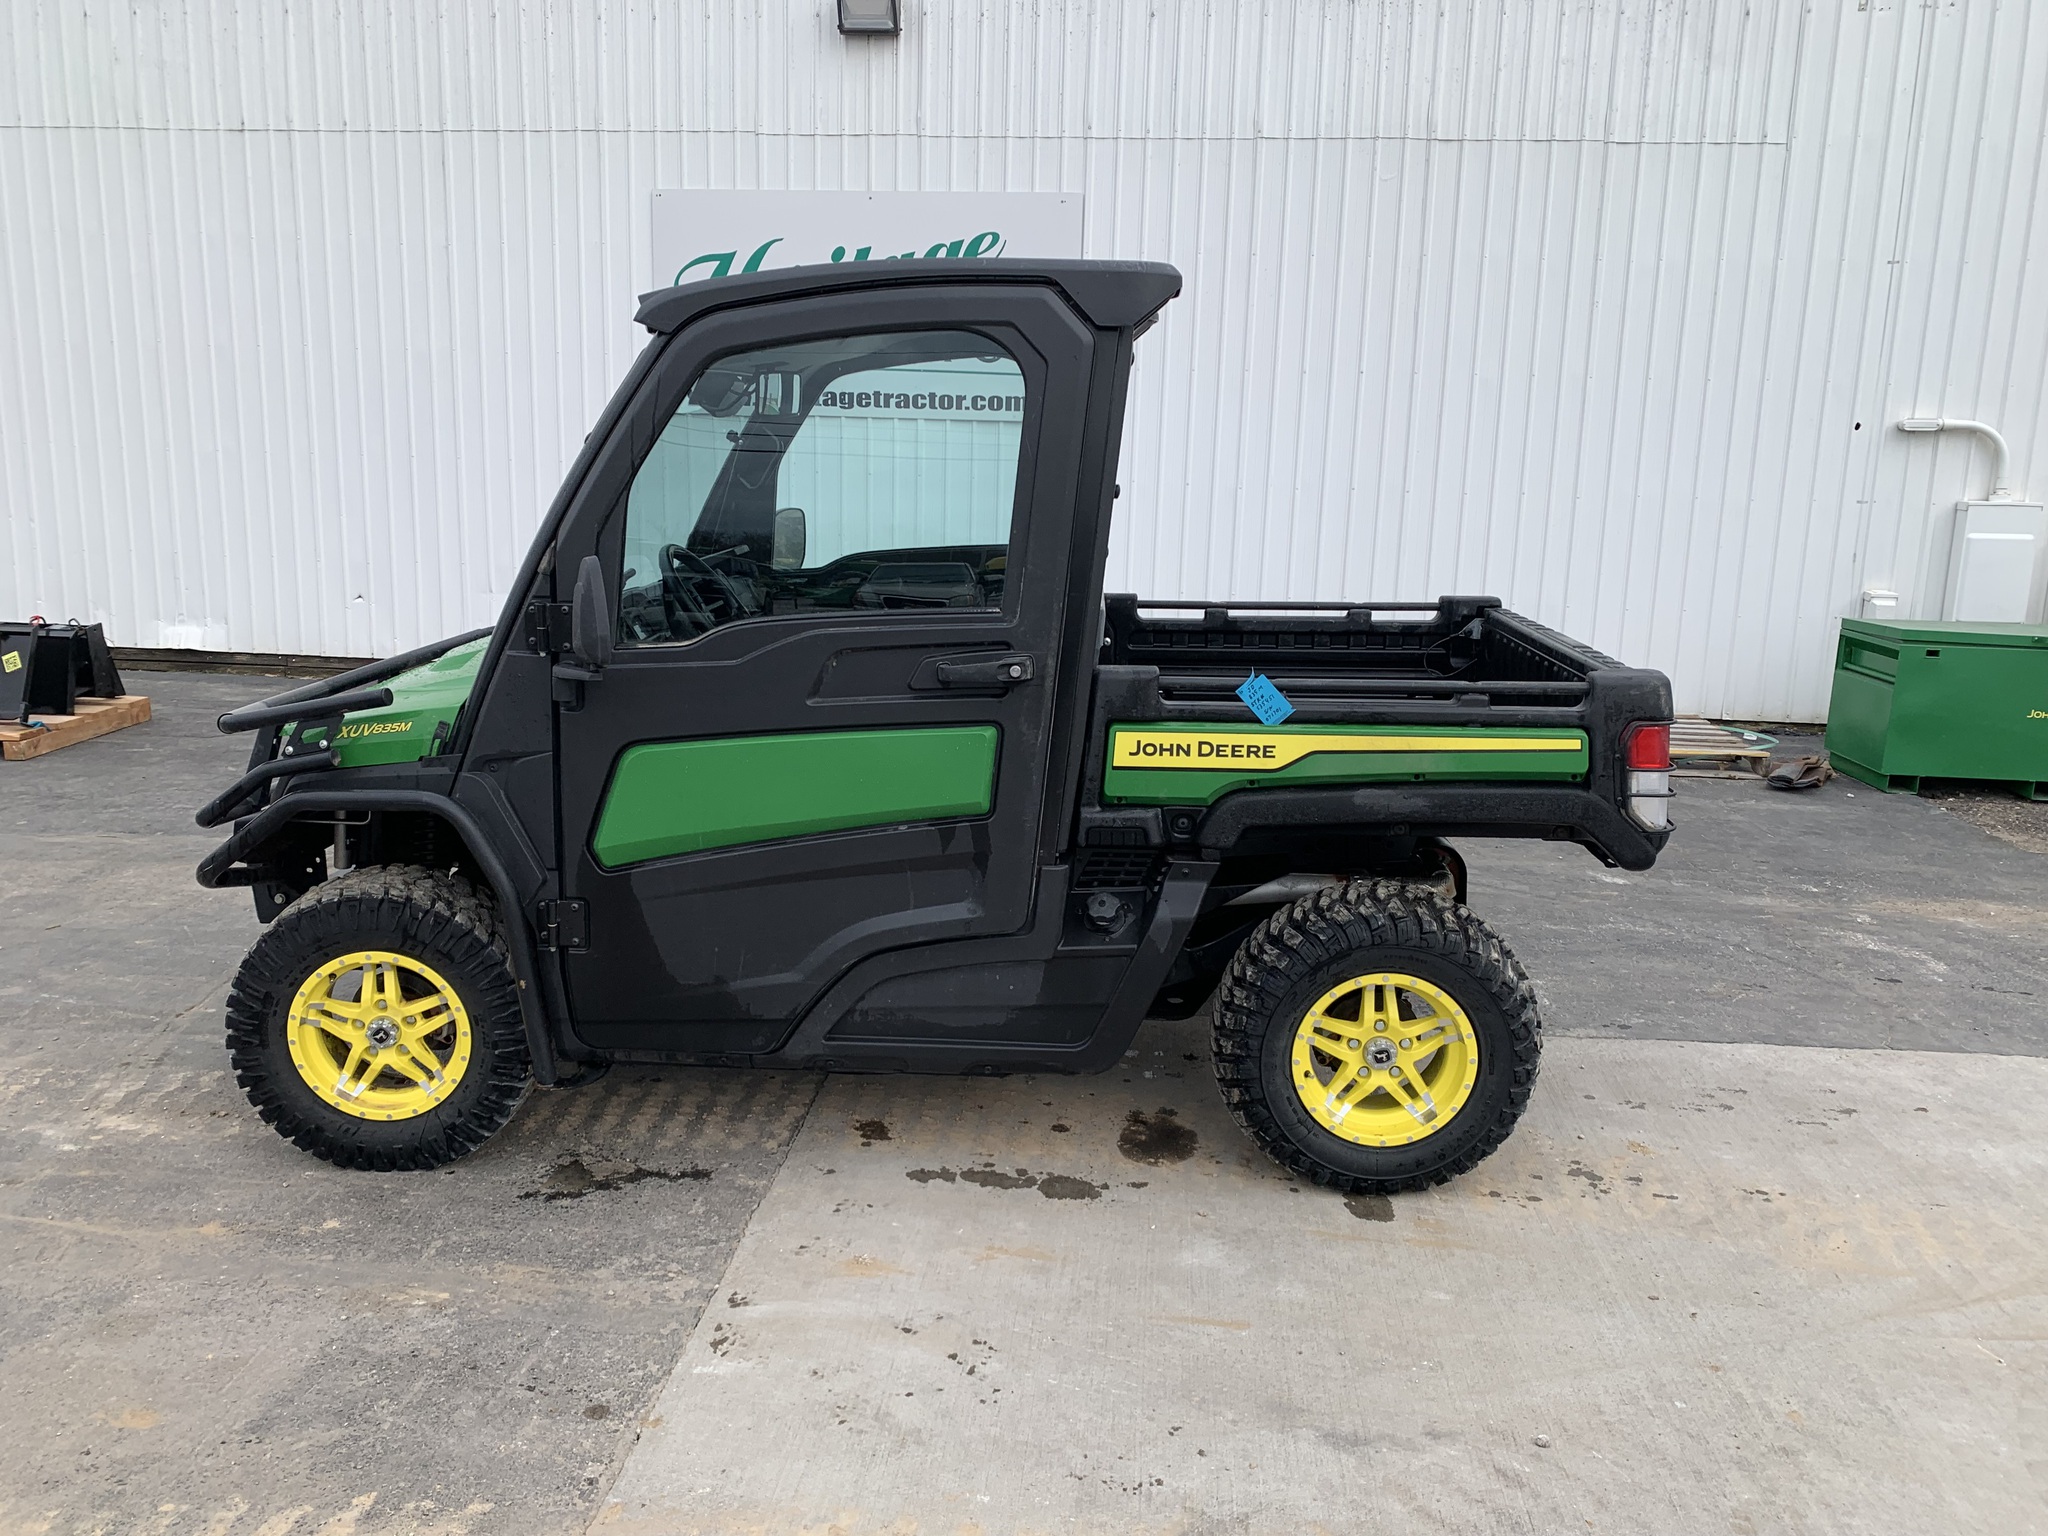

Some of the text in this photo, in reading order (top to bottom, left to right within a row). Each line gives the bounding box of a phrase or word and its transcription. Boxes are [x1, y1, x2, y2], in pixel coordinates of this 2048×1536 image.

[815, 388, 1025, 412] agetractor.com
[336, 721, 413, 739] XUV835M
[1128, 740, 1276, 759] JOHN DEERE
